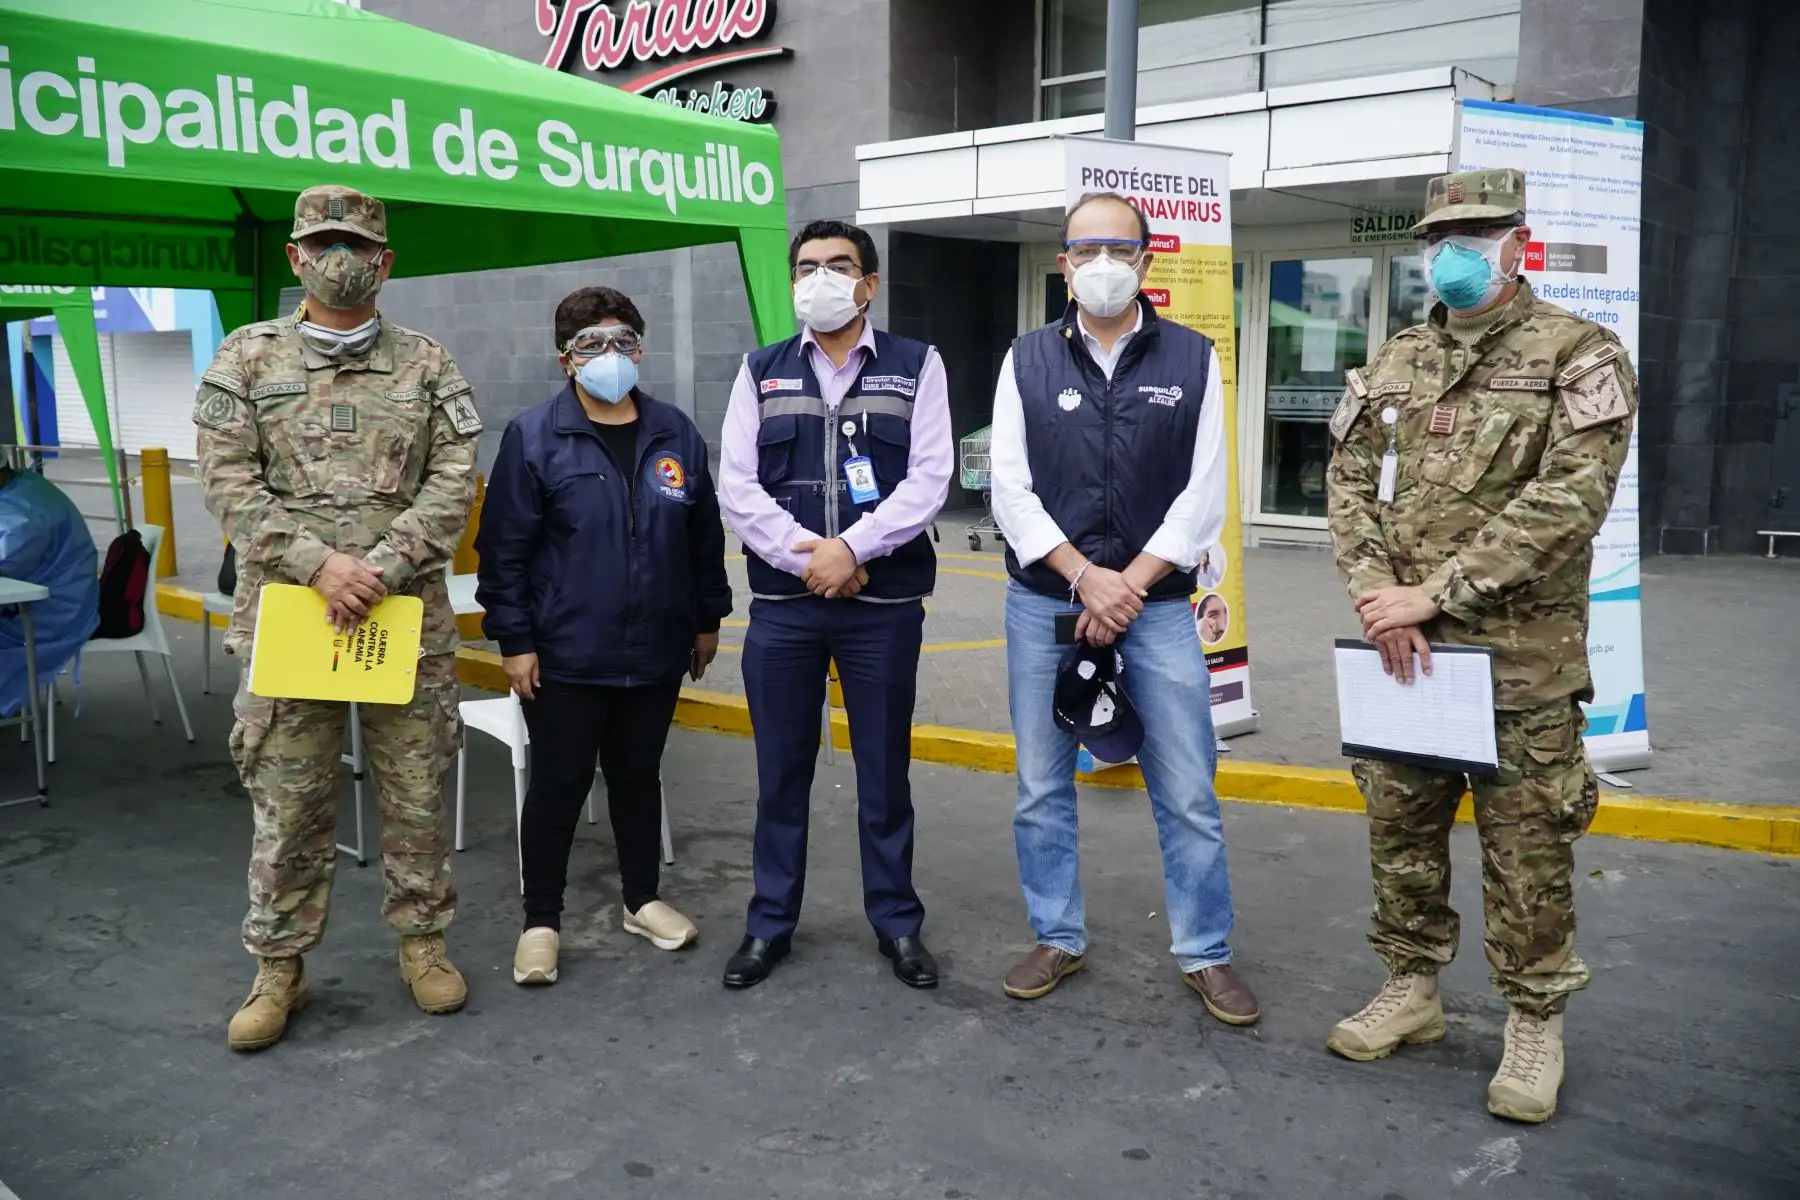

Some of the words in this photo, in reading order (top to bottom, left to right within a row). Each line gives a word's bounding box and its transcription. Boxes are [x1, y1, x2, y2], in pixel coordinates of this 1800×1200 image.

[0, 45, 412, 169] icipalidad
[432, 107, 519, 181] de
[537, 119, 775, 216] Surquillo
[1081, 166, 1184, 194] PROTÉGETE
[1188, 176, 1219, 197] DEL
[1126, 195, 1222, 223] ONAVIRUS
[1353, 214, 1418, 233] SALIDA
[1148, 238, 1175, 249] avirus?
[1352, 235, 1362, 243] DE
[1526, 250, 1543, 261] PERÚ
[1557, 260, 1573, 268] Salud
[1147, 293, 1167, 303] mite?
[1543, 283, 1580, 299] Redes
[1582, 285, 1640, 304] Integradas
[1580, 308, 1619, 324] Centro
[1523, 380, 1547, 388] AEREA
[354, 627, 366, 663] ANEMIA
[366, 621, 378, 657] CONTRA
[376, 629, 388, 665] GUERRA
[364, 659, 373, 671] LA
